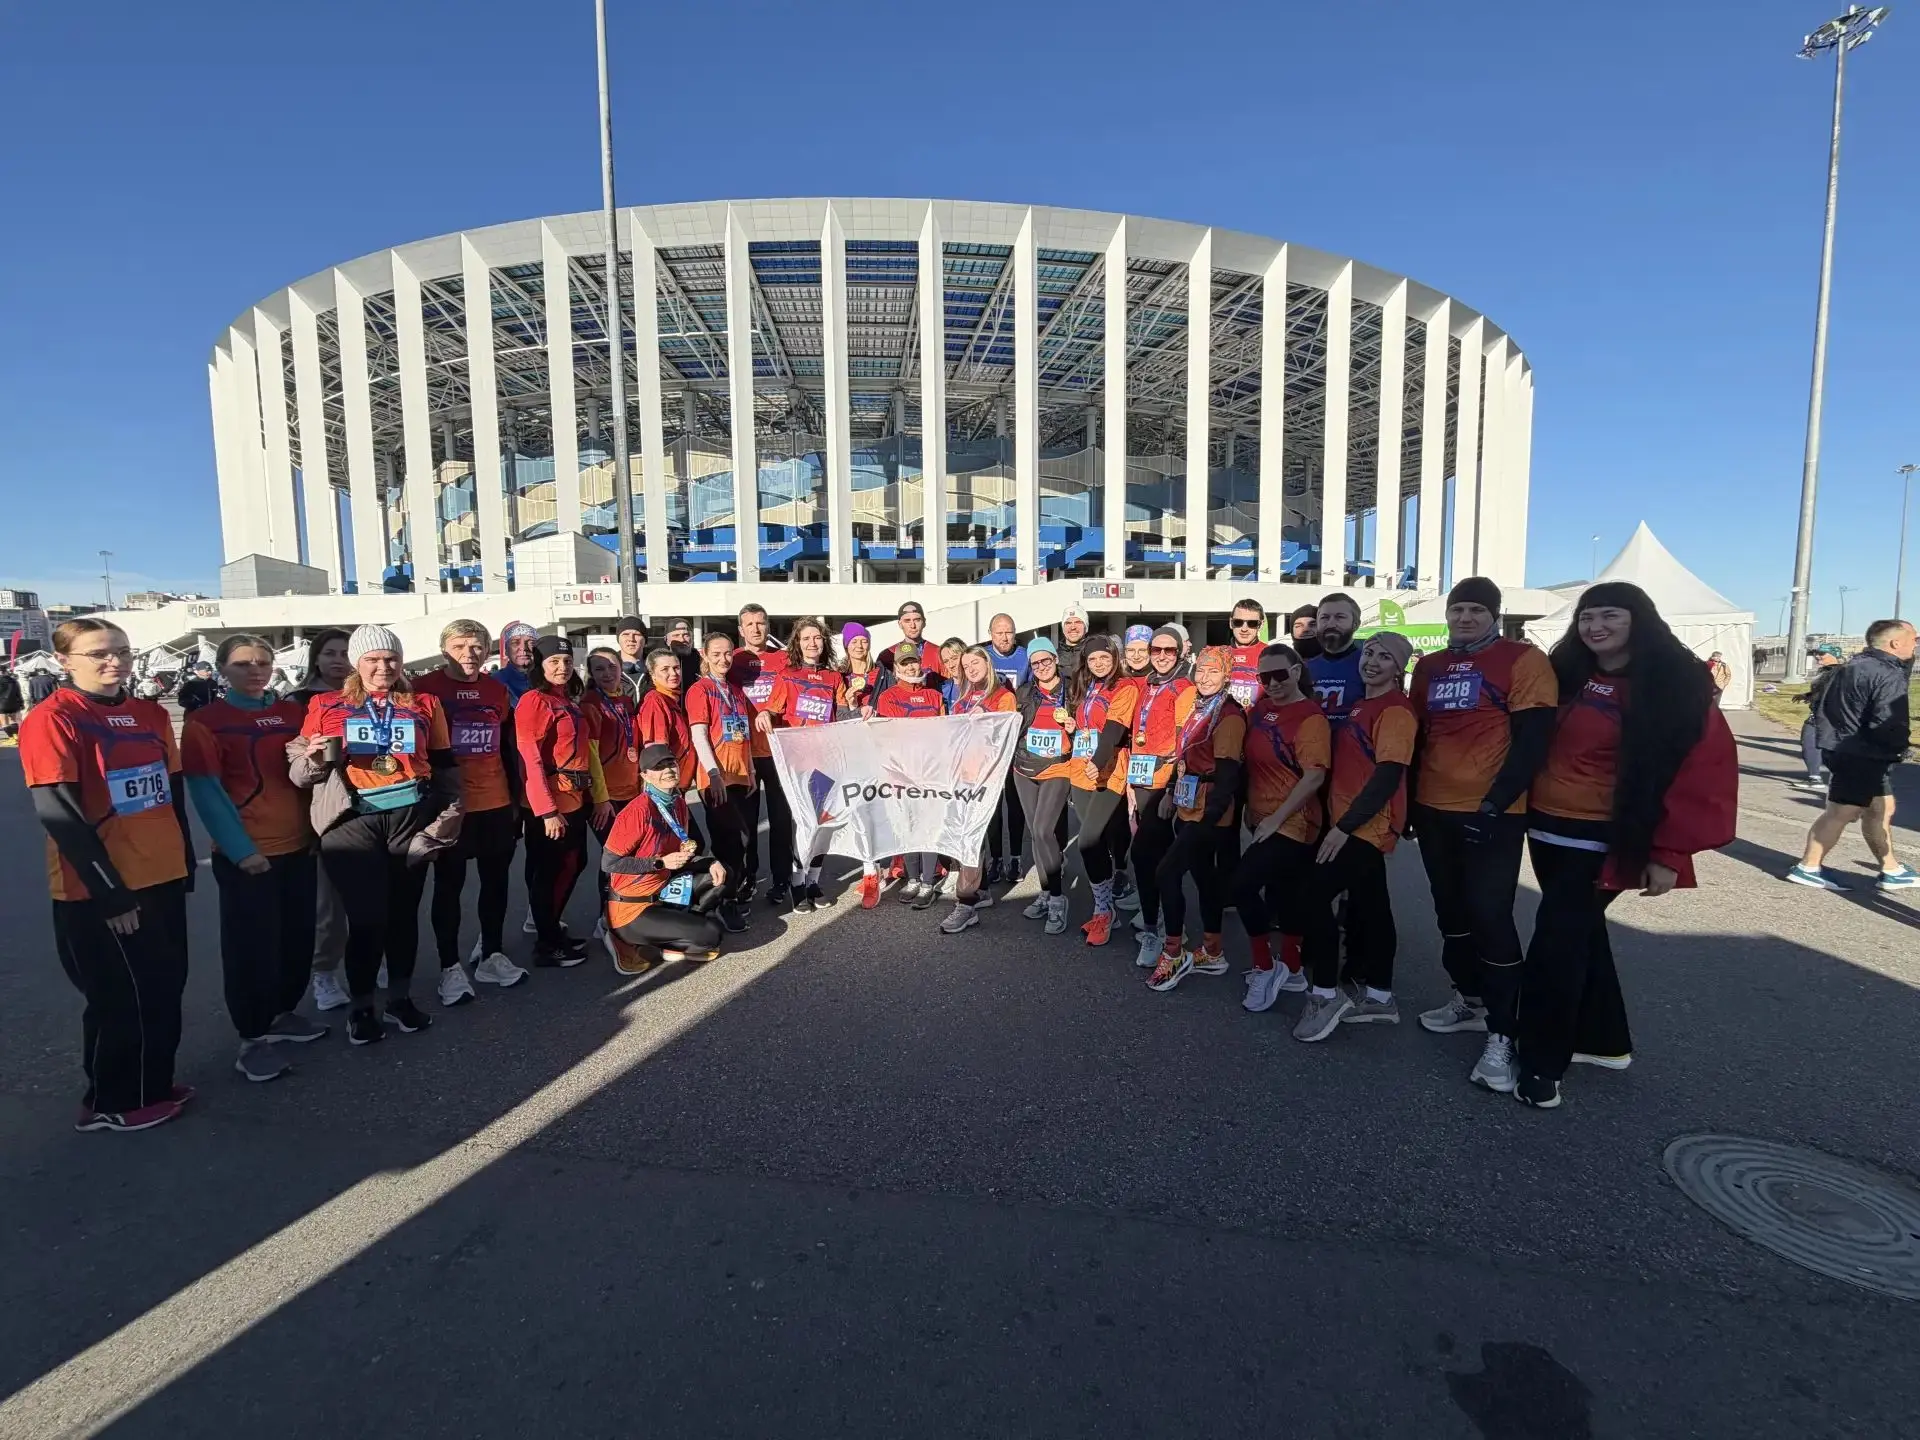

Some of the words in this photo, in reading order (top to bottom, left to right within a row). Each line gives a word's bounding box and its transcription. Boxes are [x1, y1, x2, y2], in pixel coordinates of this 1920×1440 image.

[1435, 681, 1471, 699] 2218
[801, 700, 827, 714] 2227
[1458, 698, 1469, 708] C
[461, 729, 493, 744] 2217
[1031, 735, 1057, 747] 6707
[483, 743, 493, 753] C
[1131, 762, 1149, 774] 6714
[124, 773, 164, 799] 6716
[156, 791, 165, 803] C
